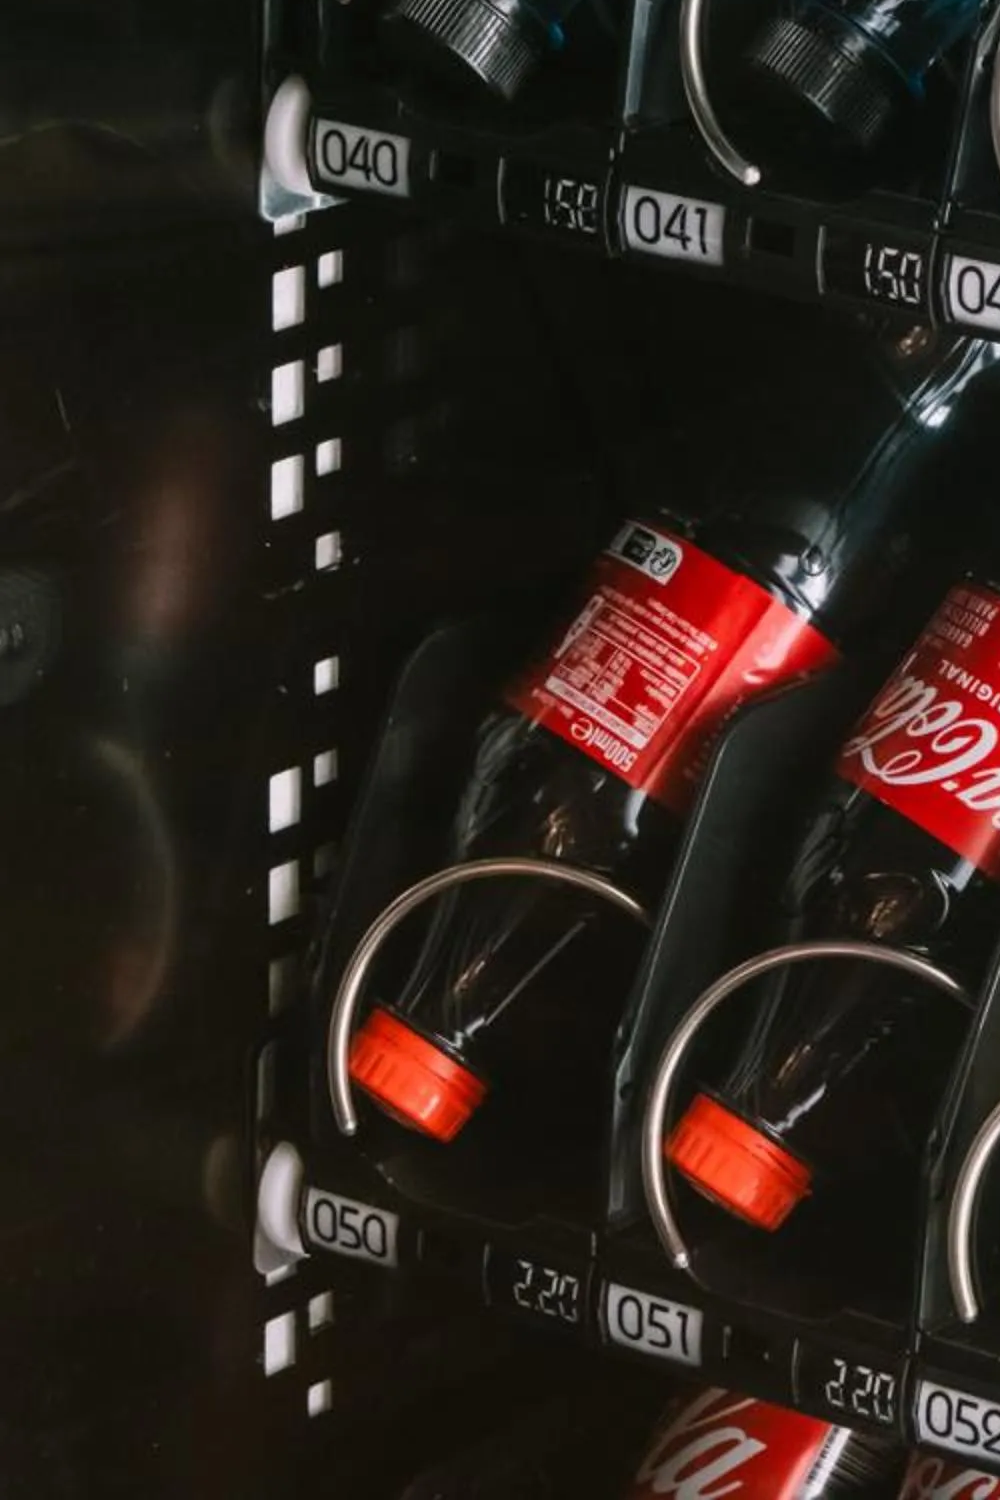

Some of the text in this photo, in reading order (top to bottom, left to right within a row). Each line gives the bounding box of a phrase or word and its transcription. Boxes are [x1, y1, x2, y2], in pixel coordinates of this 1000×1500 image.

[320, 128, 399, 188] 040
[632, 195, 709, 255] 041
[312, 1197, 388, 1260] 050
[616, 1294, 690, 1356] 051
